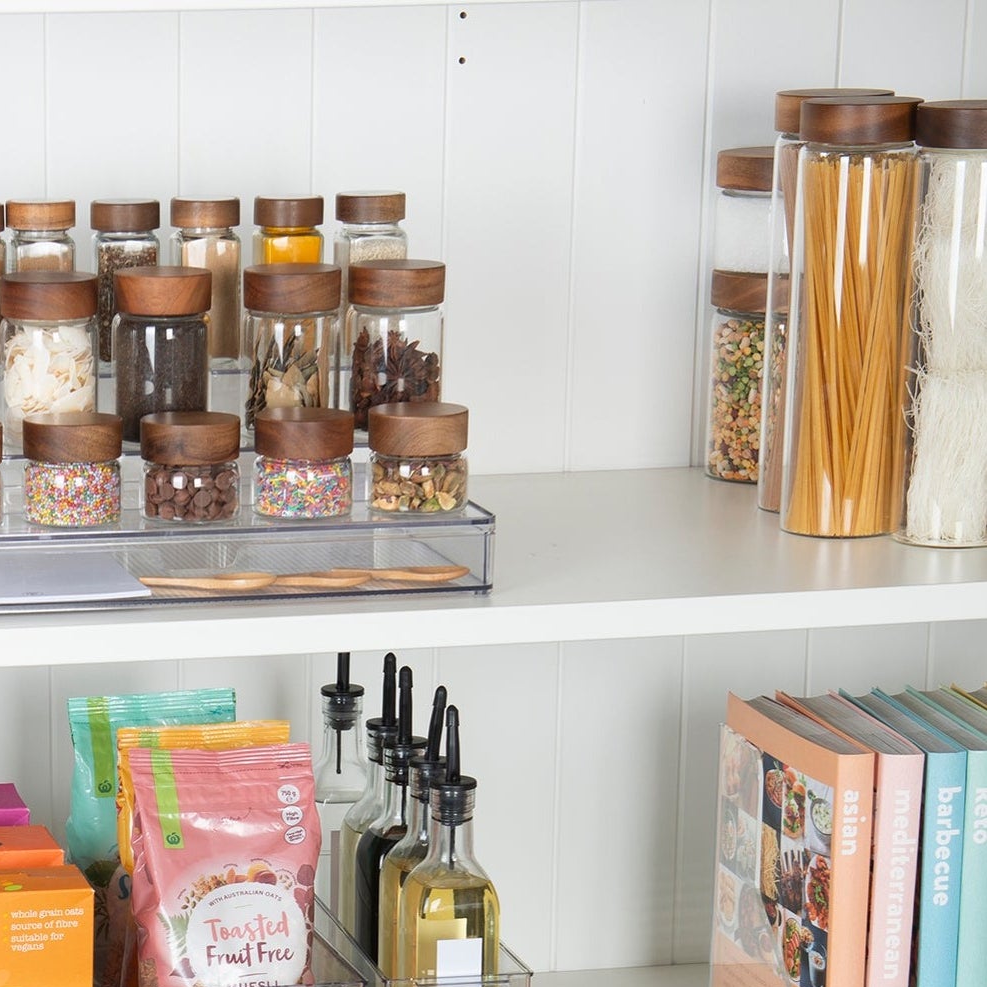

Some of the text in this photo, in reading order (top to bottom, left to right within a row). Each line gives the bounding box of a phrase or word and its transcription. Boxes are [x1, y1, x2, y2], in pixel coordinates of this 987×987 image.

[842, 787, 867, 857] asian
[933, 786, 962, 907] barbecue
[884, 788, 917, 981] mediterranean
[223, 890, 264, 900] AUSTRALIAN
[11, 909, 38, 919] whole
[65, 907, 85, 917] oats
[11, 919, 79, 931] source of fibre
[203, 911, 289, 942] Toasted
[11, 932, 65, 943] suitable for
[11, 943, 44, 952] vegans
[206, 941, 294, 967] Fruit Free
